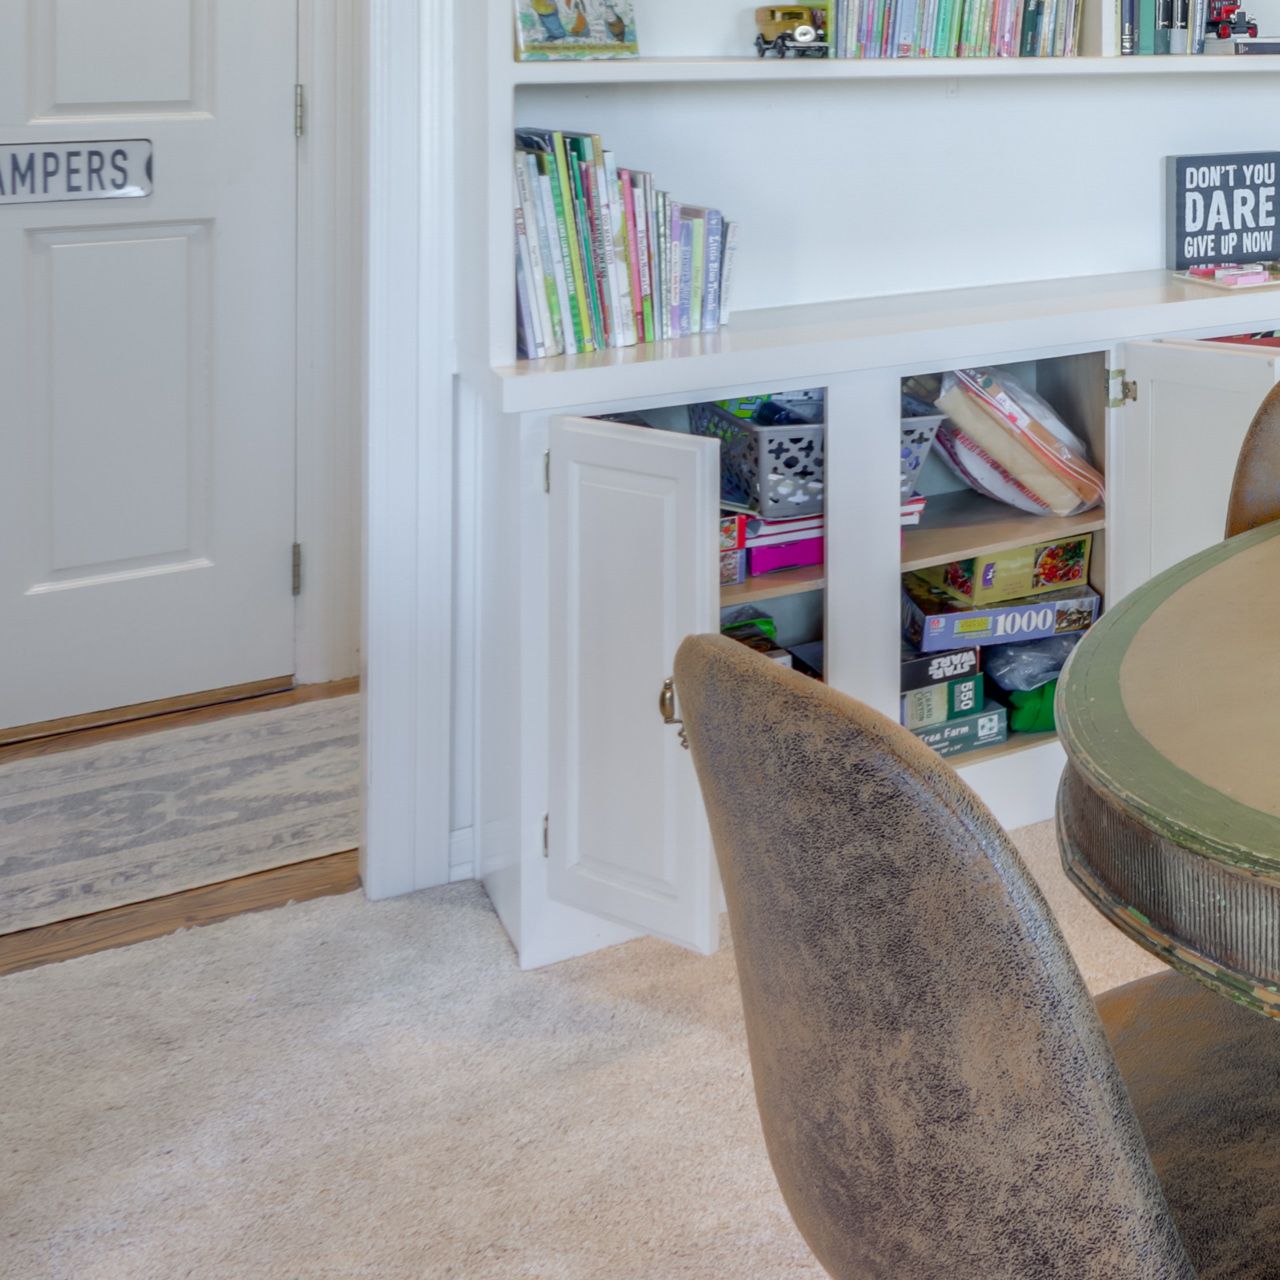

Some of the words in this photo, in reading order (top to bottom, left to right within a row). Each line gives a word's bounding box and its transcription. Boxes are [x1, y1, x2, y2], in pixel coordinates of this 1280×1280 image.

[0, 149, 129, 195] MPERS
[1185, 164, 1238, 189] DON'T
[1242, 162, 1276, 186] YOU
[1184, 186, 1276, 233] DARE
[708, 235, 719, 261] Little
[1184, 235, 1216, 258] GIVE
[1221, 233, 1238, 255] UP
[1243, 231, 1273, 254] NOW
[708, 263, 718, 282] Blue
[707, 283, 717, 311] Truck
[993, 608, 1054, 637] 1000
[928, 663, 971, 680] STAR
[931, 650, 977, 670] WARS
[961, 681, 974, 711] 550
[944, 725, 969, 738] Farm
